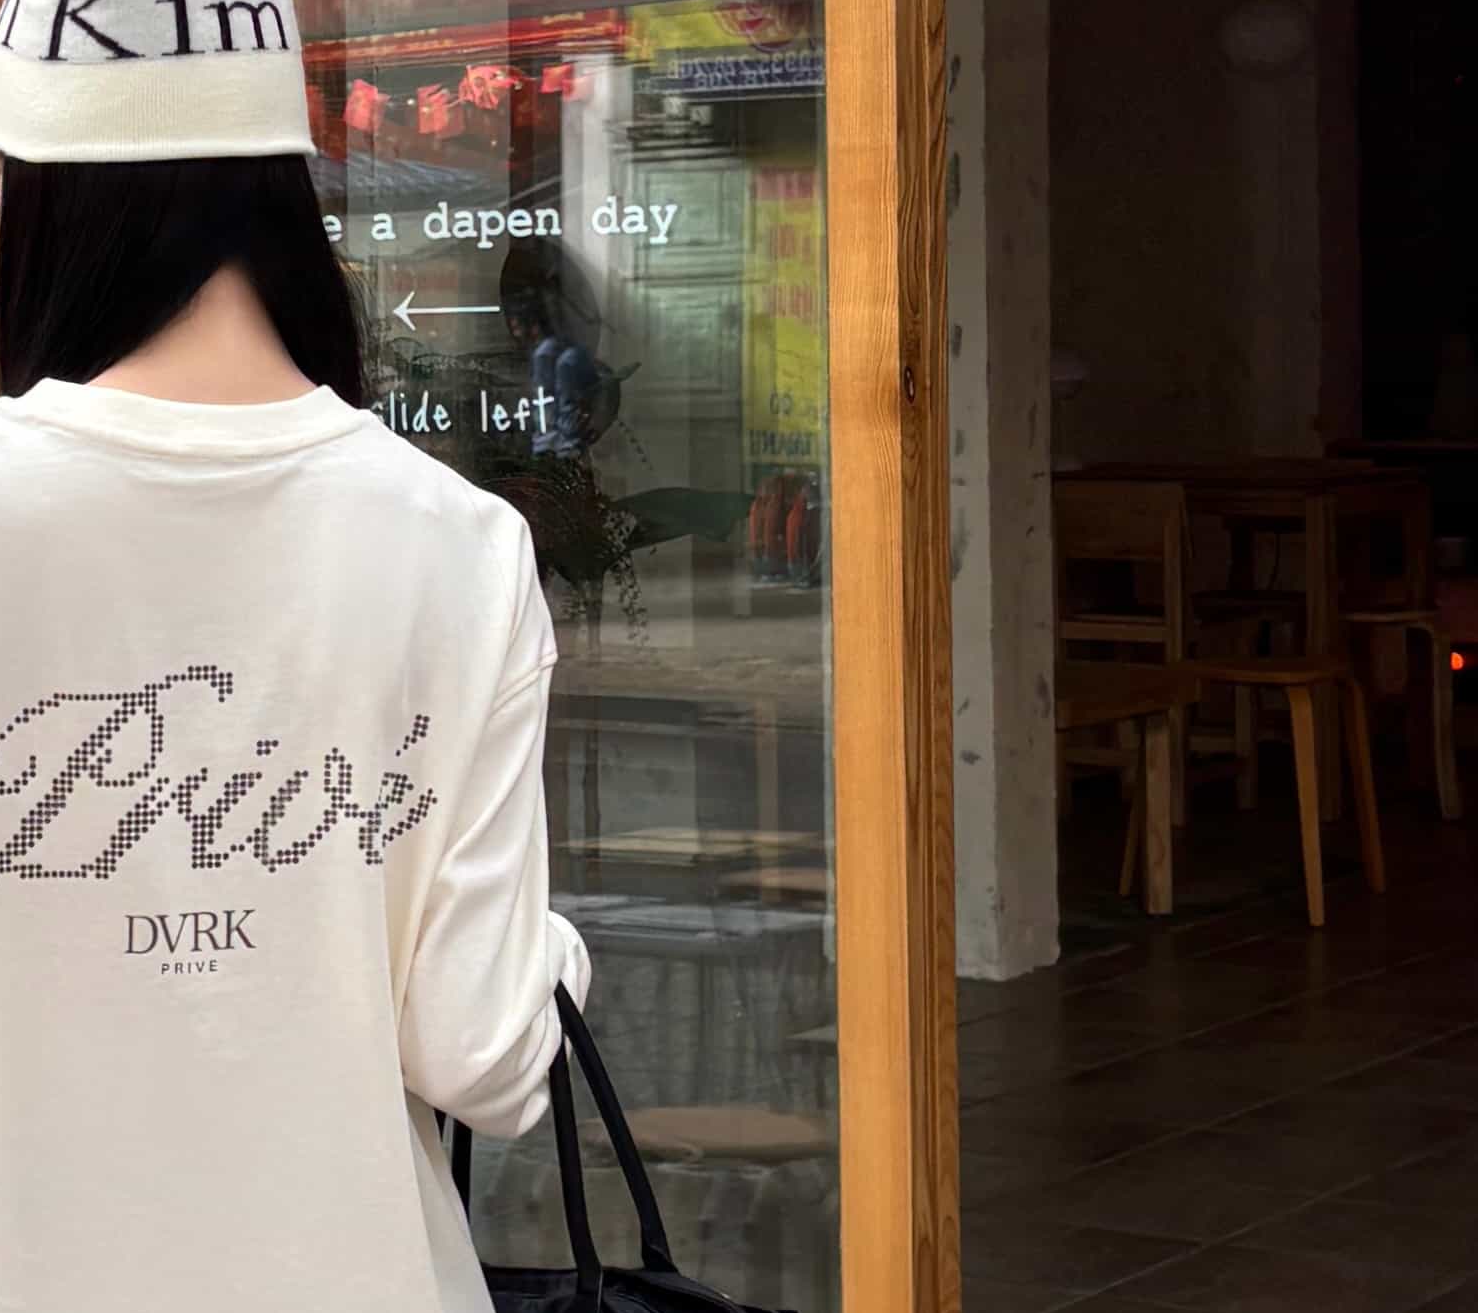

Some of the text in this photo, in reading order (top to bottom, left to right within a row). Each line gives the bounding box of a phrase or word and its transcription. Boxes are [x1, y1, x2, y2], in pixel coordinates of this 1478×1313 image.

[371, 213, 396, 241] a
[423, 201, 563, 249] dapen
[591, 196, 678, 244] day
[480, 385, 555, 434] left
[124, 909, 258, 954] DVRK
